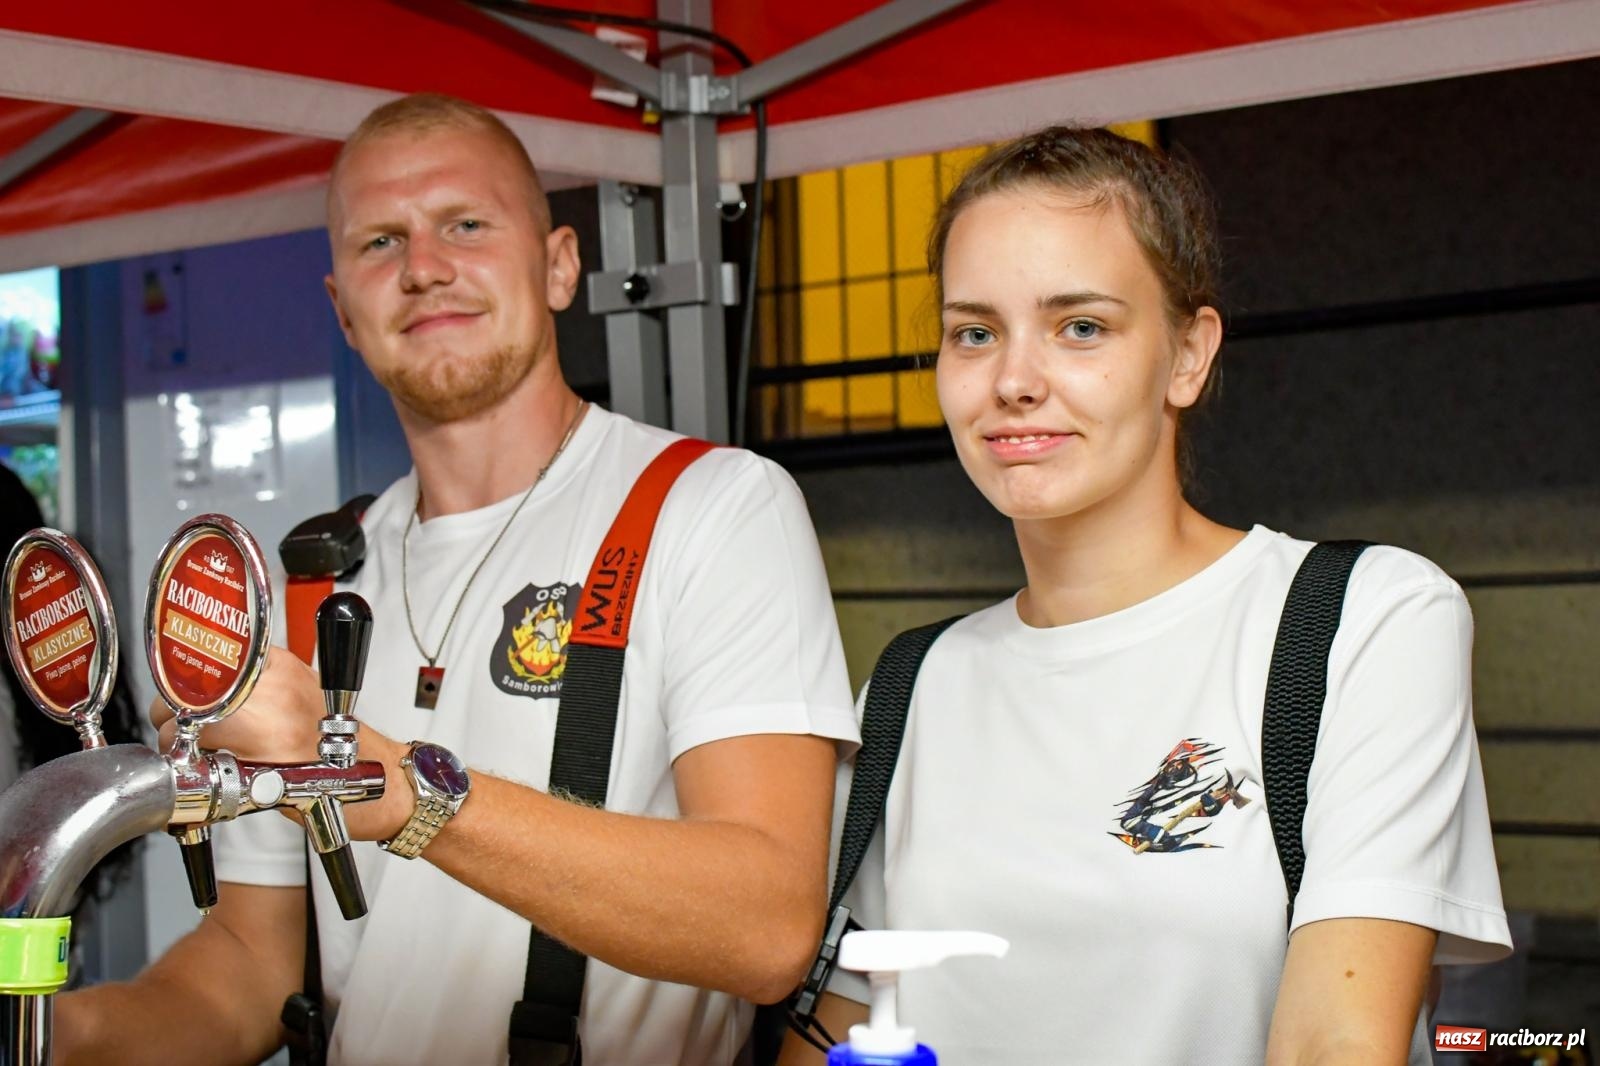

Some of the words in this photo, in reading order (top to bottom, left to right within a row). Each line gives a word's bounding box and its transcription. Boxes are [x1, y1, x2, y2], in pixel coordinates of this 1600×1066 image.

[167, 578, 250, 638] RACIBORSKIE
[580, 546, 626, 632] WUS
[16, 587, 86, 643] RACIBORSKIE
[171, 616, 236, 661] KLASYCZNE
[33, 623, 88, 664] KLASYCZNE
[172, 646, 187, 661] Piwo
